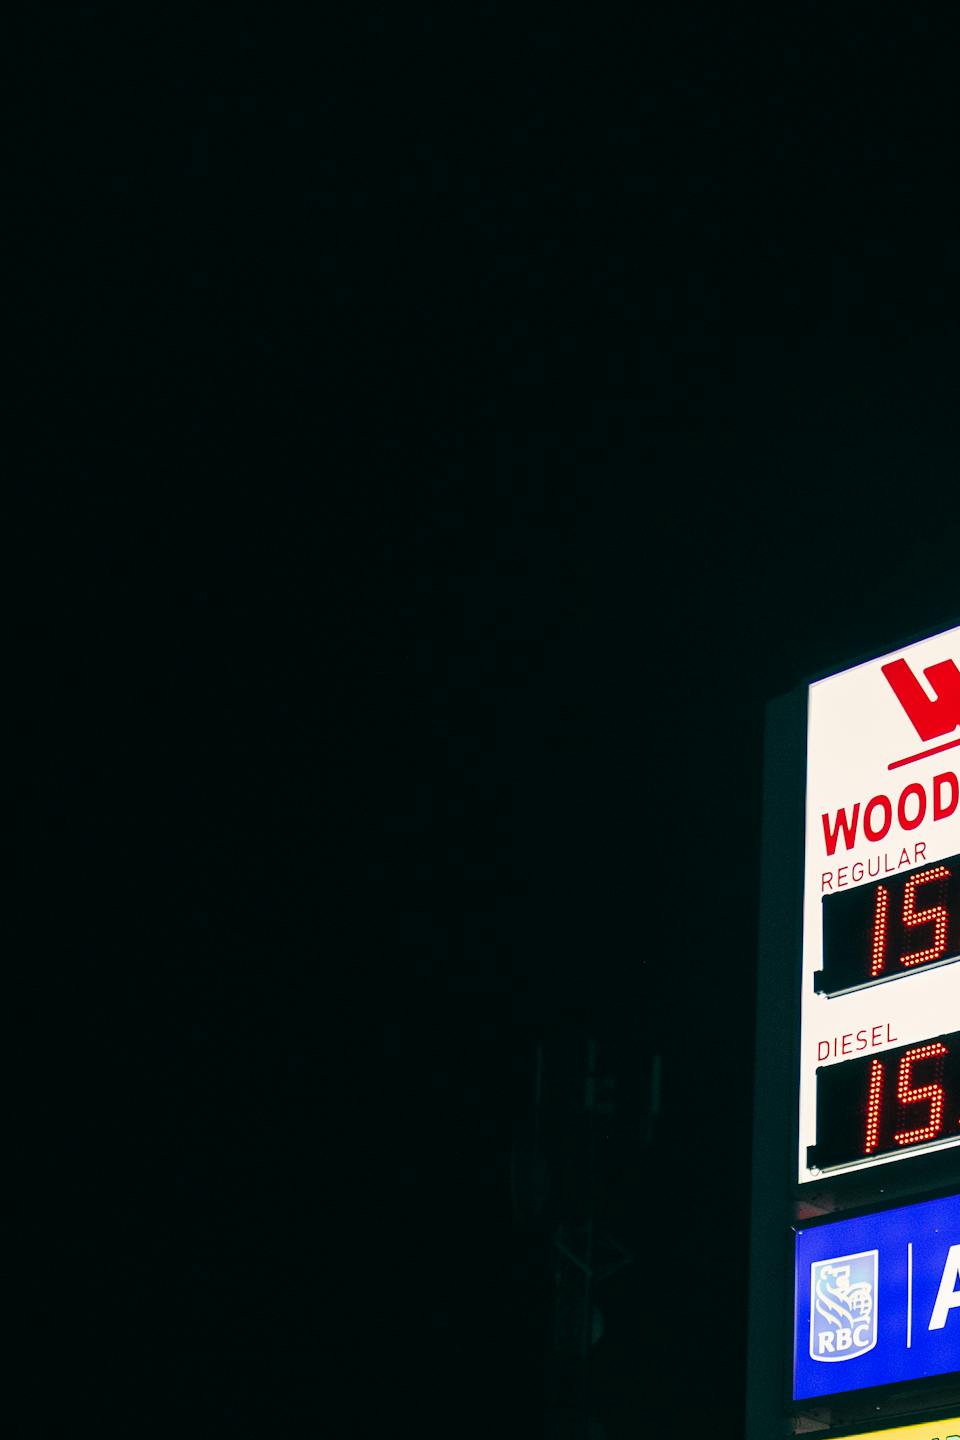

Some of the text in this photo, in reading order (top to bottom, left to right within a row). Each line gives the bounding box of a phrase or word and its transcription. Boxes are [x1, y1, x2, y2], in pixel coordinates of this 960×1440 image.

[821, 841, 927, 893] REGULAR
[817, 1023, 898, 1062] DIESEL
[818, 1324, 870, 1354] RBC
